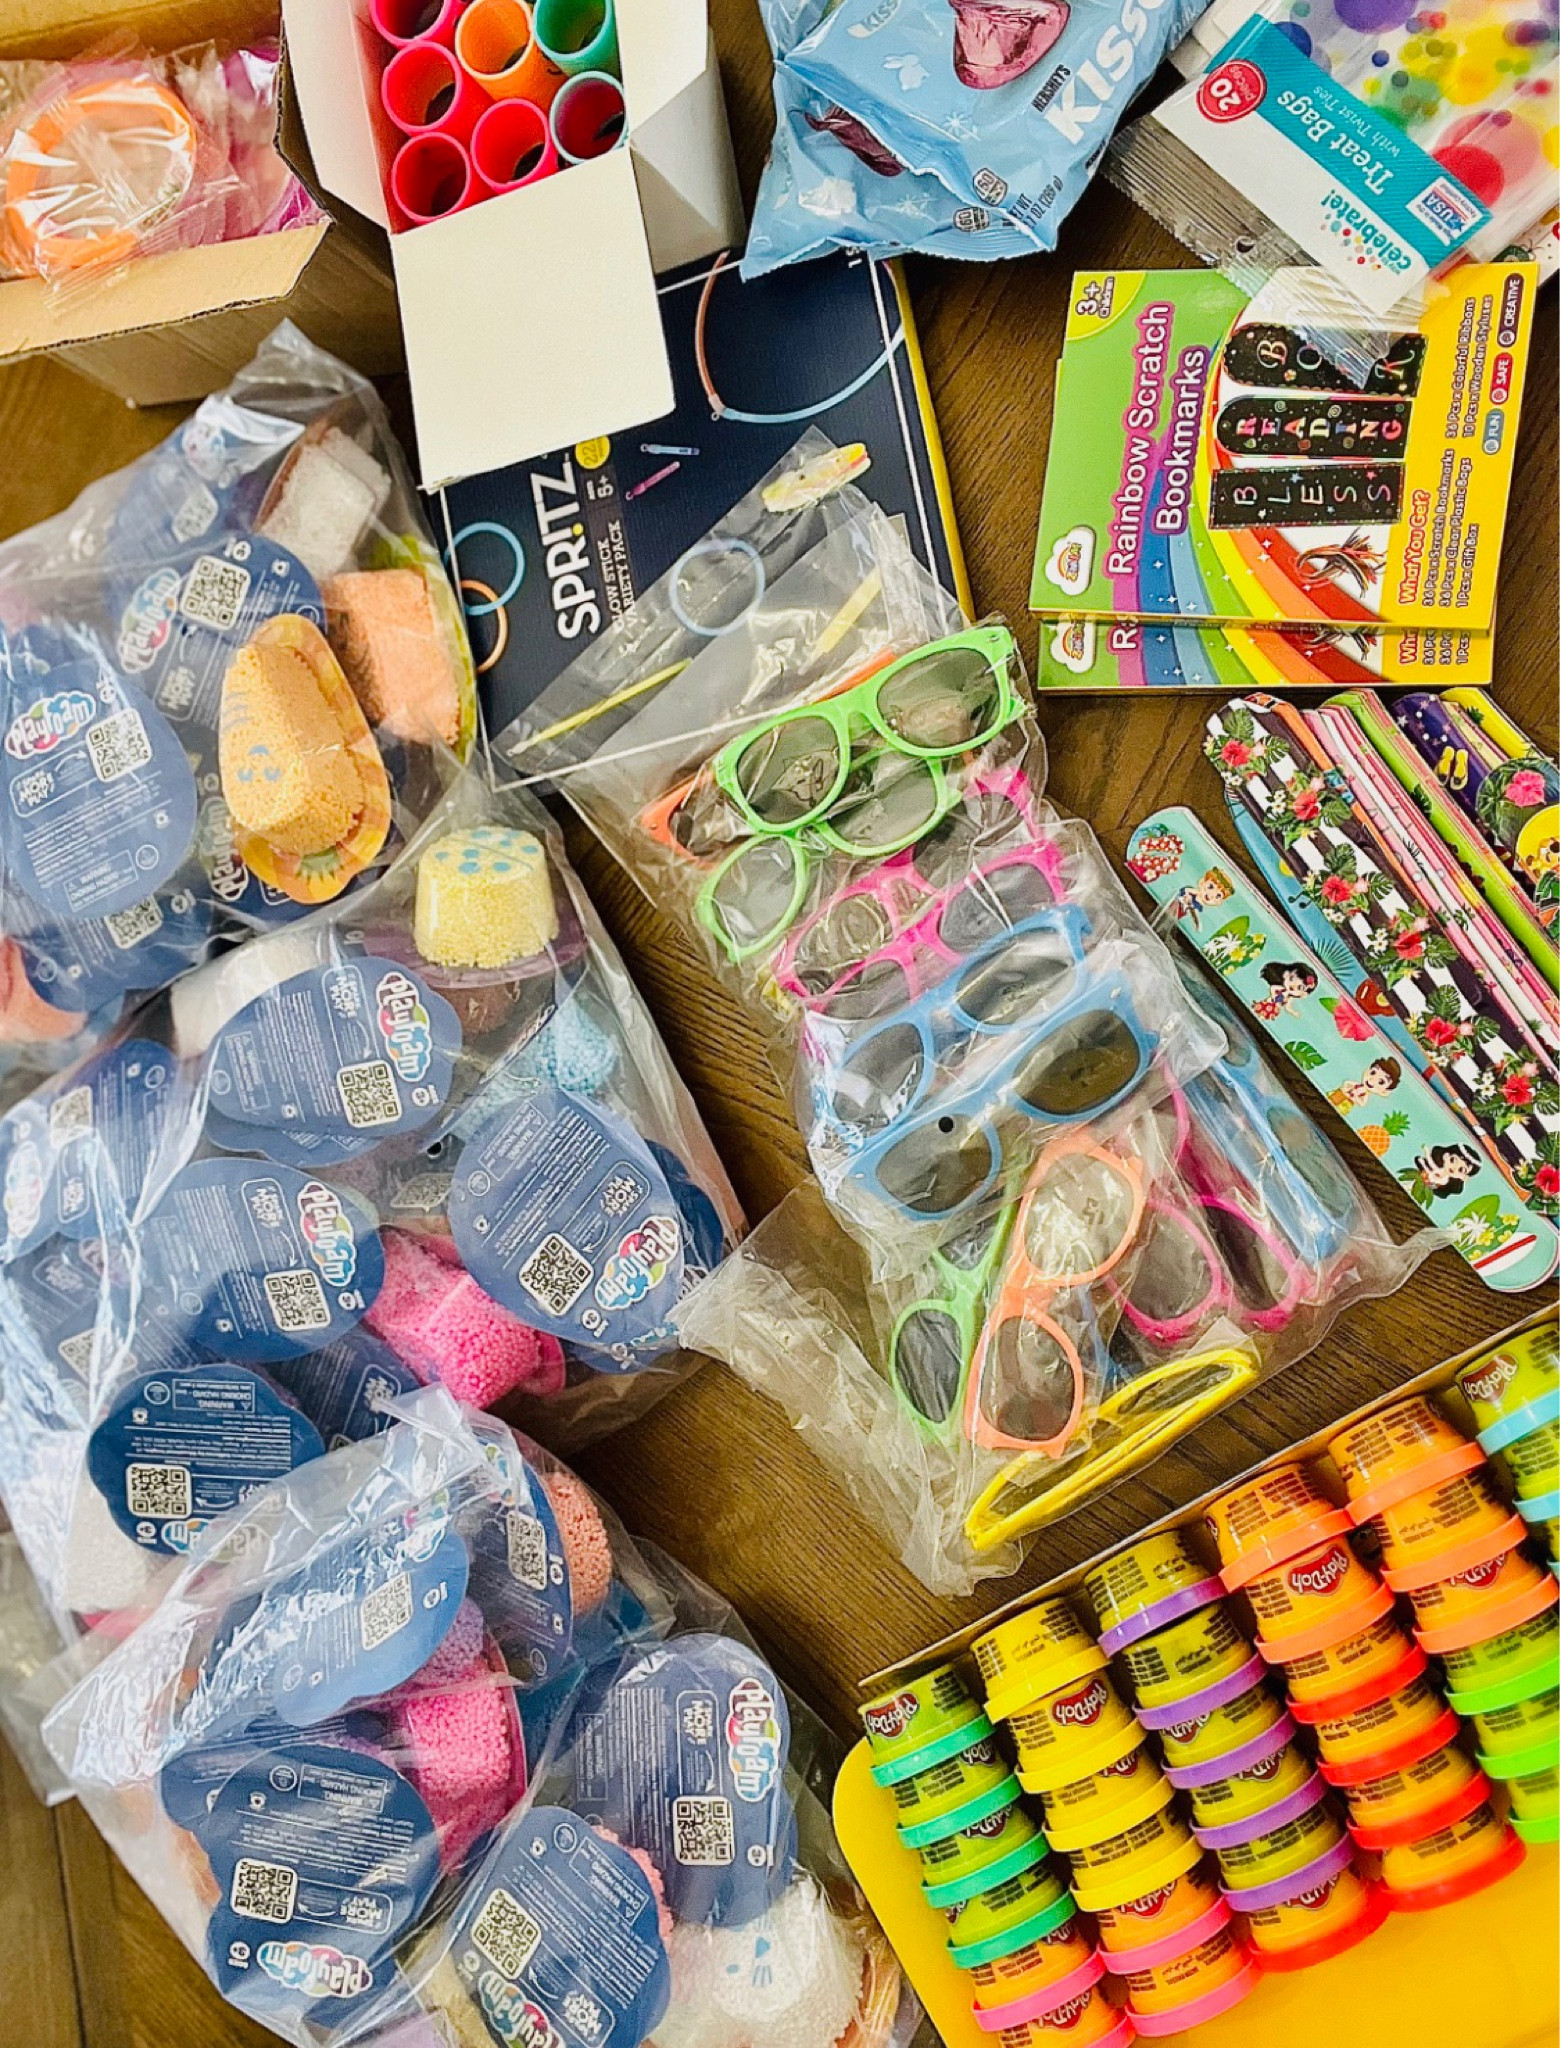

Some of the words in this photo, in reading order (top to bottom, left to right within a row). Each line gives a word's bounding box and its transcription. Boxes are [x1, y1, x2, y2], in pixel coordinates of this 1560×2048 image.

[1031, 64, 1071, 112] HERSHEY'S
[1044, 0, 1165, 145] KISS
[1229, 66, 1255, 100] pieces
[1207, 79, 1240, 112] 20
[1271, 82, 1338, 145] Bags
[1309, 83, 1339, 112] Ties
[1335, 104, 1372, 138] Twist
[1323, 129, 1395, 196] Treat
[1368, 129, 1402, 161] with
[1031, 203, 1045, 219] OZ
[1424, 193, 1455, 222] USA
[1320, 188, 1412, 273] celebrate!
[1076, 281, 1101, 316] 3+
[1504, 278, 1520, 327] CREATIVE
[1458, 296, 1476, 343] Ribbons
[1476, 294, 1494, 343] Styluses
[1128, 305, 1169, 430] Scratch
[1452, 345, 1469, 390] Colorful
[1469, 343, 1486, 392] Wooden
[1496, 358, 1509, 384] SAFE
[1236, 414, 1402, 441] READING
[1445, 422, 1458, 438] 36
[1448, 400, 1462, 422] Pcs
[1463, 424, 1475, 437] 10
[1465, 402, 1478, 423] Pcs
[1489, 413, 1501, 436] FUN
[580, 438, 596, 465] 22
[1155, 349, 1204, 530] Bookmarks
[1435, 448, 1455, 513] Bookmarks
[1456, 456, 1472, 486] Bags
[1108, 436, 1151, 574] Rainbow
[1233, 481, 1391, 506] BLESS
[1410, 489, 1429, 526] Get?
[1450, 488, 1467, 526] Plastic
[608, 519, 626, 561] PACK
[1404, 526, 1424, 561] You
[1428, 514, 1446, 559] Scratch
[1445, 527, 1461, 559] Clear
[1465, 522, 1479, 546] Box
[597, 537, 616, 582] STICK
[1462, 546, 1476, 569] Gift
[615, 562, 638, 627] VARIETY
[1398, 561, 1421, 604] What
[1425, 567, 1439, 588] Pcs
[1441, 568, 1455, 589] Pcs
[1458, 578, 1471, 599] Pcs
[605, 584, 624, 631] GLOW
[1422, 590, 1435, 606] 36
[1439, 591, 1452, 607] 36
[127, 574, 177, 666] Playfoam
[10, 698, 91, 755] Playfoam
[335, 975, 355, 1018] MORE
[381, 980, 425, 1074] Playfoam
[256, 1186, 278, 1229] MORE
[596, 1174, 624, 1205] PLAY
[601, 1174, 637, 1217] MORE
[299, 1188, 347, 1279] Playfoam
[599, 1222, 676, 1304] Playfoam
[1461, 1356, 1517, 1396] Play-Doh
[170, 1522, 268, 1556] Plaam
[1287, 1551, 1348, 1590] Play-Doh
[682, 1708, 694, 1734] PLAY
[865, 1694, 919, 1733] Play-Doh
[1053, 1682, 1107, 1722] Play-Doh
[691, 1700, 705, 1745] MORE
[734, 1688, 772, 1791] Playfoam
[339, 1903, 381, 1920] MORE
[265, 1946, 361, 1989] Playfoam
[481, 1976, 557, 2048] ayfoam
